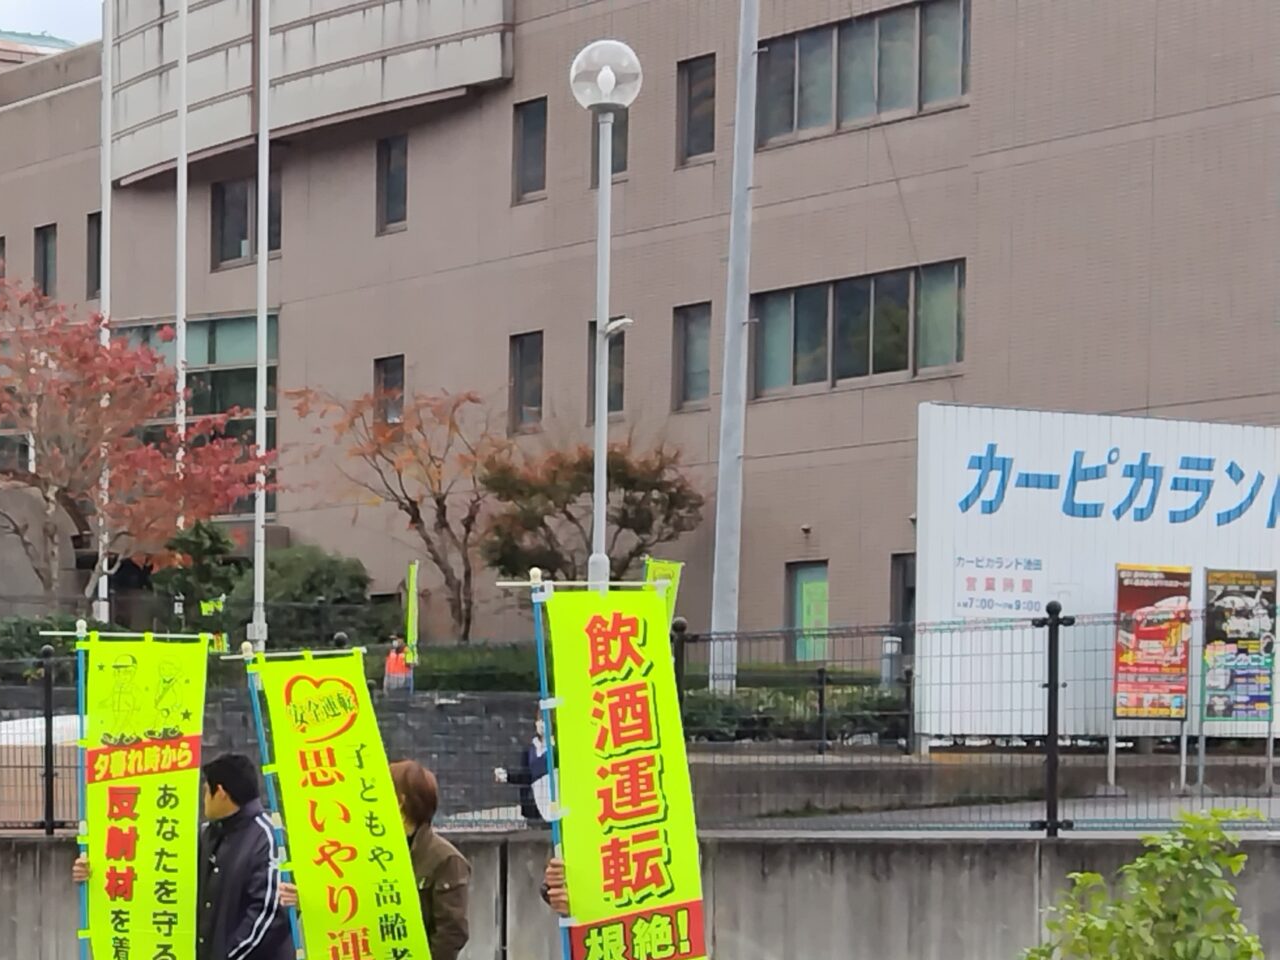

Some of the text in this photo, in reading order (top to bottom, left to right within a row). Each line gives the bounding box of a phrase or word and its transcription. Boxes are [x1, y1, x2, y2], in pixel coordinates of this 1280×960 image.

[94, 742, 193, 781] 夕暮れ時から
[585, 612, 670, 906] 飲酒運転
